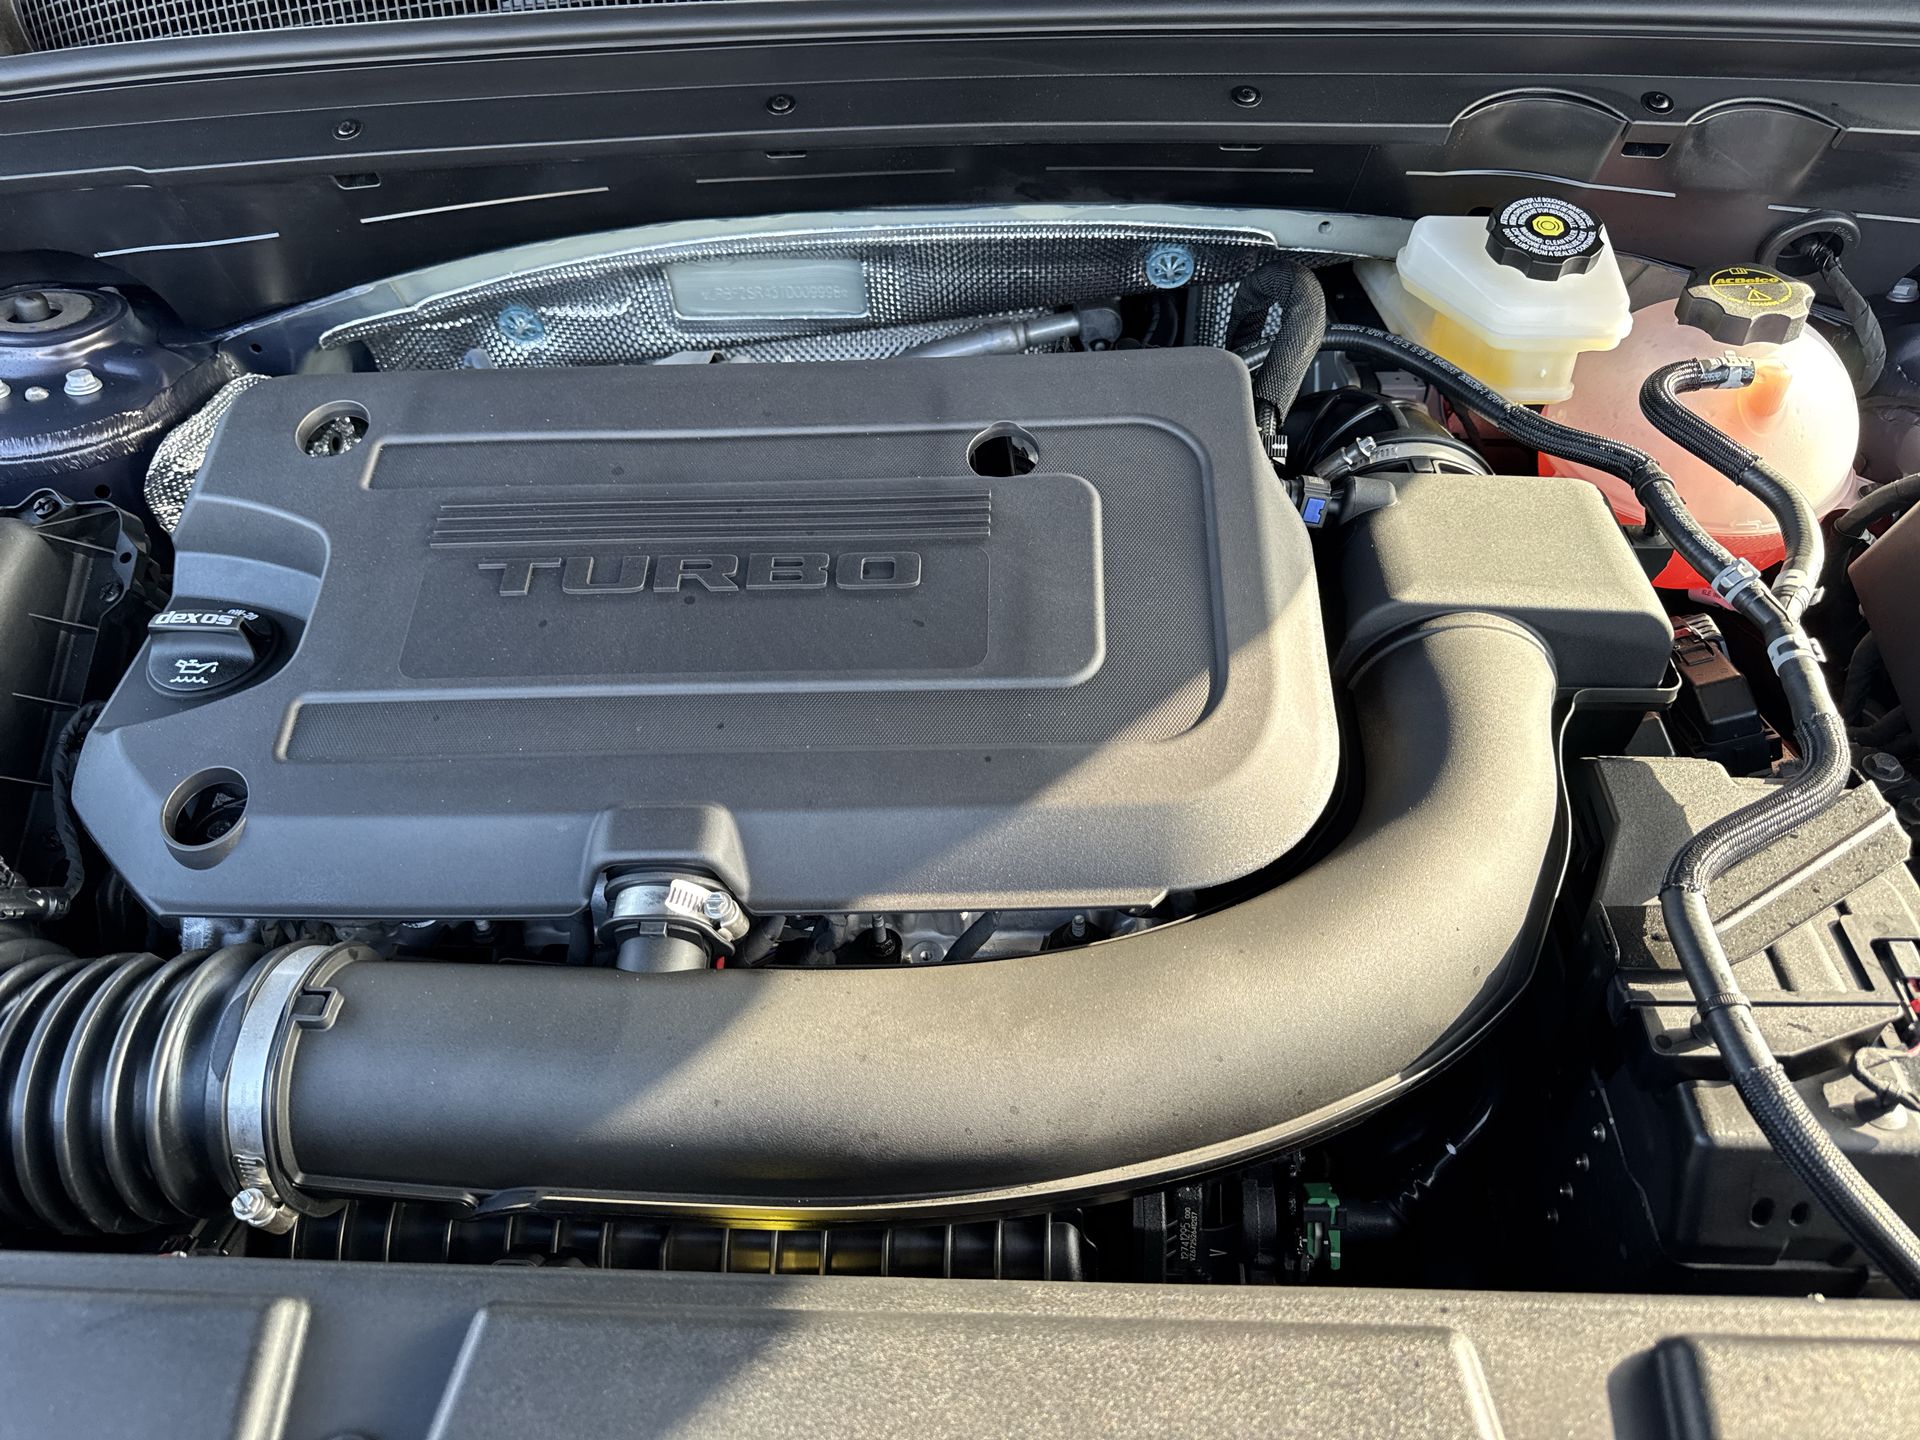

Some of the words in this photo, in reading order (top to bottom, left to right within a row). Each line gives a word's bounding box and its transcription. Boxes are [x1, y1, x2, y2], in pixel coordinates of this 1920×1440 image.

[1510, 238, 1529, 250] FLUID
[1527, 246, 1547, 255] FROM
[1516, 235, 1540, 248] BEFORE
[1714, 277, 1779, 285] ACDelco
[479, 551, 922, 596] TURBO
[155, 611, 237, 625] dexos
